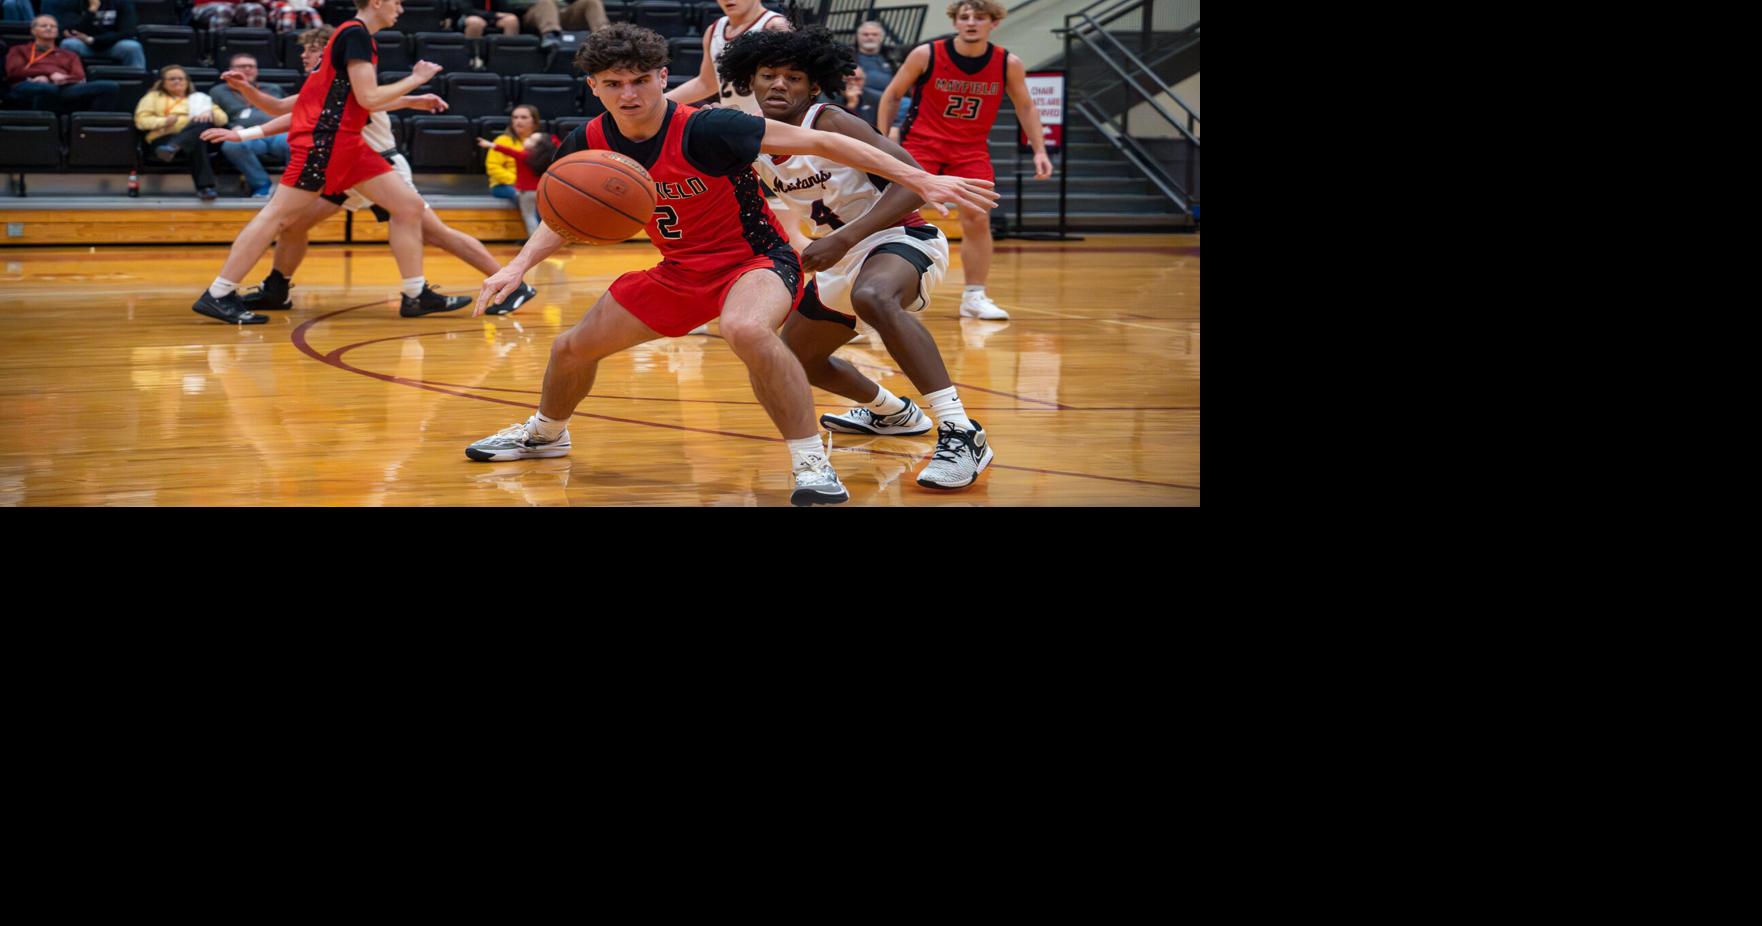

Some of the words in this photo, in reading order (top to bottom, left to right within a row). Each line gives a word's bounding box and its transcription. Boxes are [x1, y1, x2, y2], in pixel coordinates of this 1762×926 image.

[935, 77, 1000, 96] MAYFIELD
[1031, 86, 1055, 95] CHAIR
[943, 94, 982, 120] 23
[654, 176, 709, 200] IELD
[773, 170, 832, 193] Mustangs
[811, 199, 846, 231] 4
